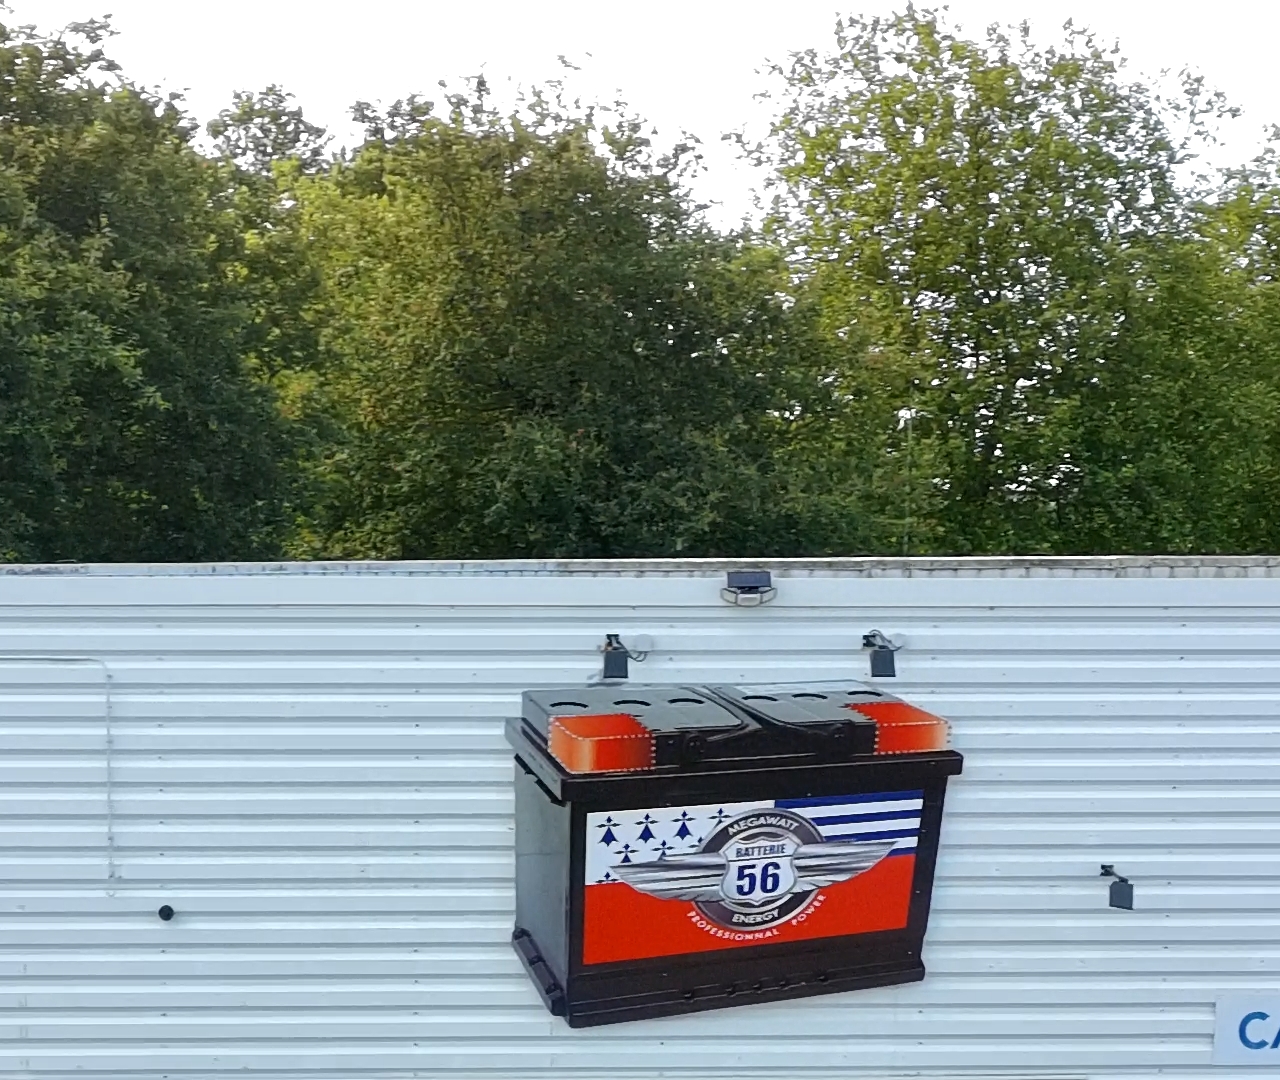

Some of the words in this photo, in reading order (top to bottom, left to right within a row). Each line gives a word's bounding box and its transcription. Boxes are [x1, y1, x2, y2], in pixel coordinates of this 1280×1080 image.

[727, 815, 800, 836] MEGAWATT
[735, 843, 787, 858] BATTERIE
[736, 861, 782, 896] 56
[686, 910, 781, 941] PROFESSIONNAL
[791, 894, 827, 926] POWER
[731, 908, 779, 924] ENERGY
